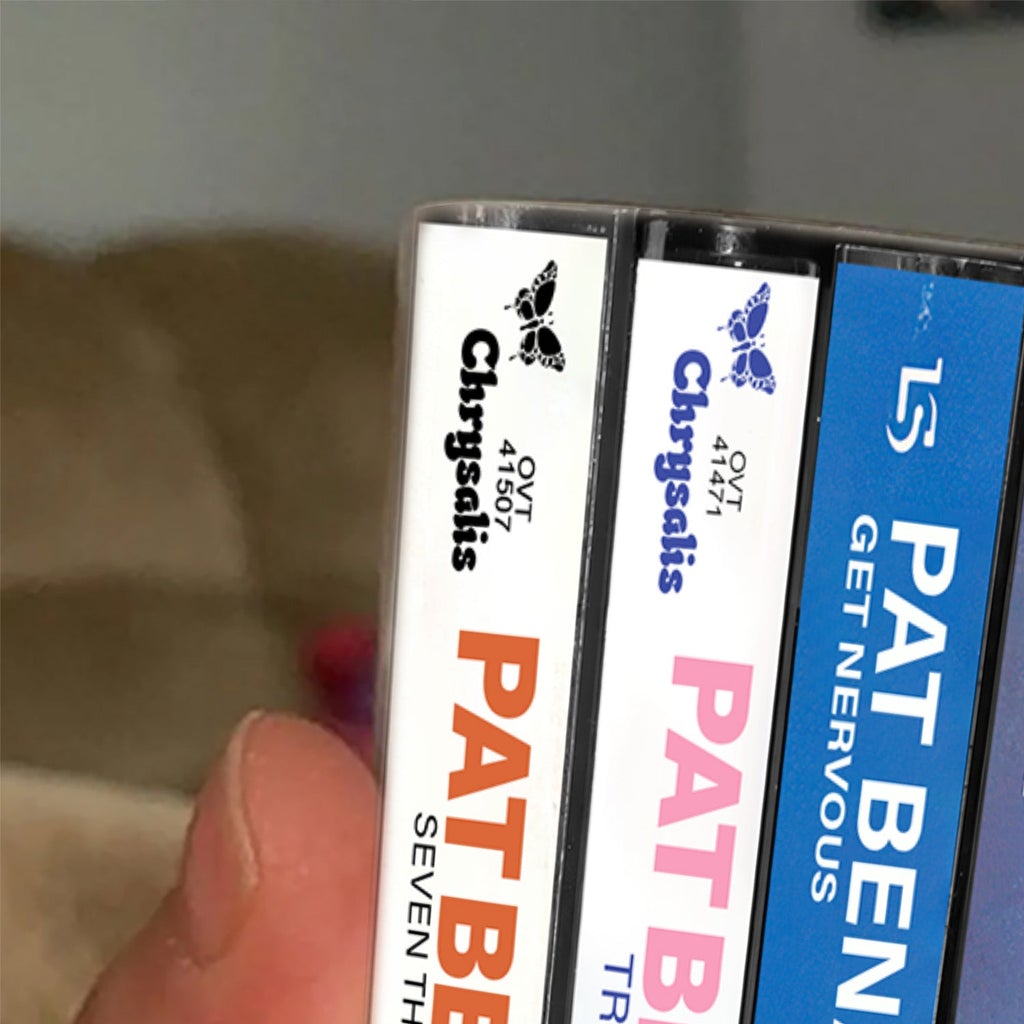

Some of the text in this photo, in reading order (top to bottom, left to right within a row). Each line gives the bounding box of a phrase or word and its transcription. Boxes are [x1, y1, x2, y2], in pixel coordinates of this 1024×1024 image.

[443, 328, 502, 573] Chrysalis
[493, 438, 517, 533] 41507
[514, 455, 536, 524] OVT
[653, 349, 713, 596] Chrysalis
[705, 435, 729, 518] 41471
[726, 450, 748, 513] OVT
[805, 513, 879, 903] GET NERVOUS
[870, 520, 960, 747] PAT
[444, 629, 540, 882] PAT
[653, 655, 754, 911] PAT
[405, 812, 438, 959] SEVEN
